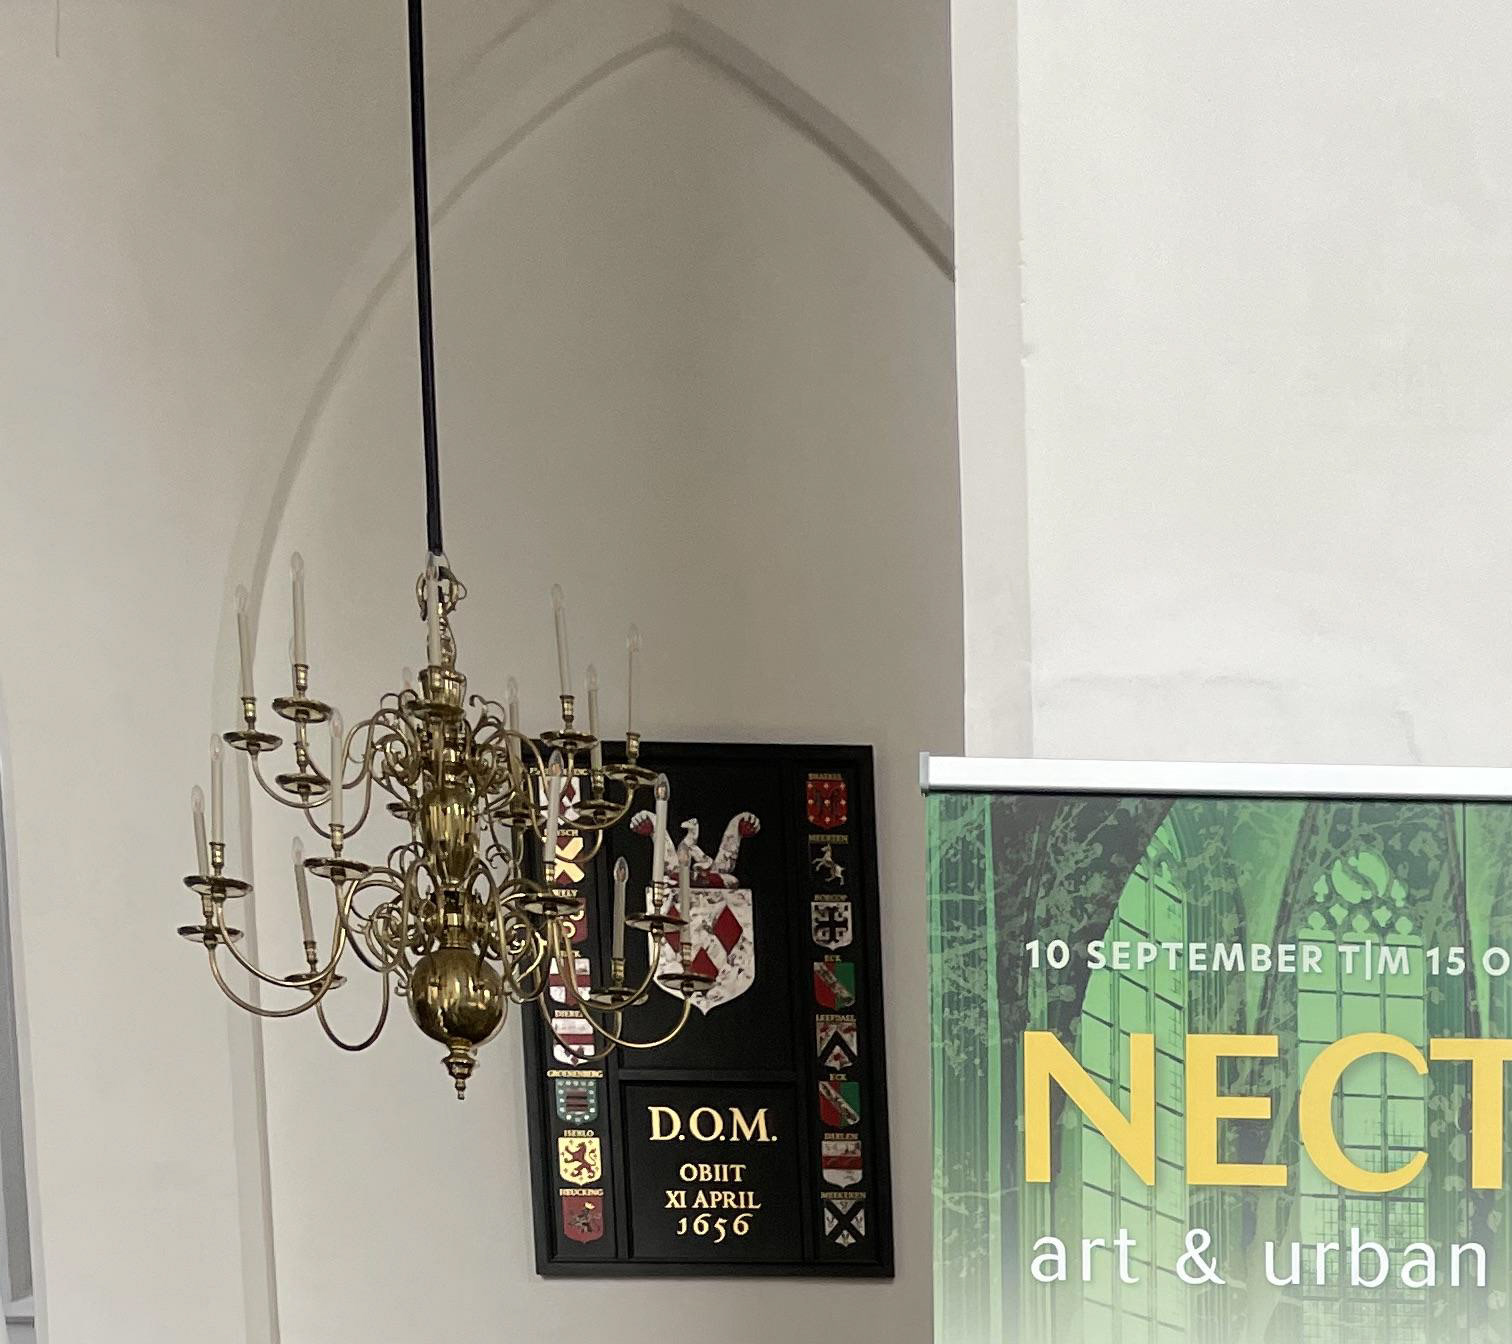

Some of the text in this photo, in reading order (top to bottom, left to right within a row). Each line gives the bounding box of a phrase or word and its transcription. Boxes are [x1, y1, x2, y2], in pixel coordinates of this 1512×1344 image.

[1026, 940, 1069, 968] 10
[1088, 941, 1322, 972] SEPTEMBER
[1427, 947, 1465, 975] 15
[648, 1106, 777, 1141] D.O.M.
[680, 1163, 746, 1182] OBIIT
[665, 1190, 761, 1208] XI APRIL
[677, 1213, 753, 1243] 1656
[1029, 1227, 1139, 1283] art
[1176, 1228, 1226, 1286] &
[1264, 1228, 1488, 1289] urban
